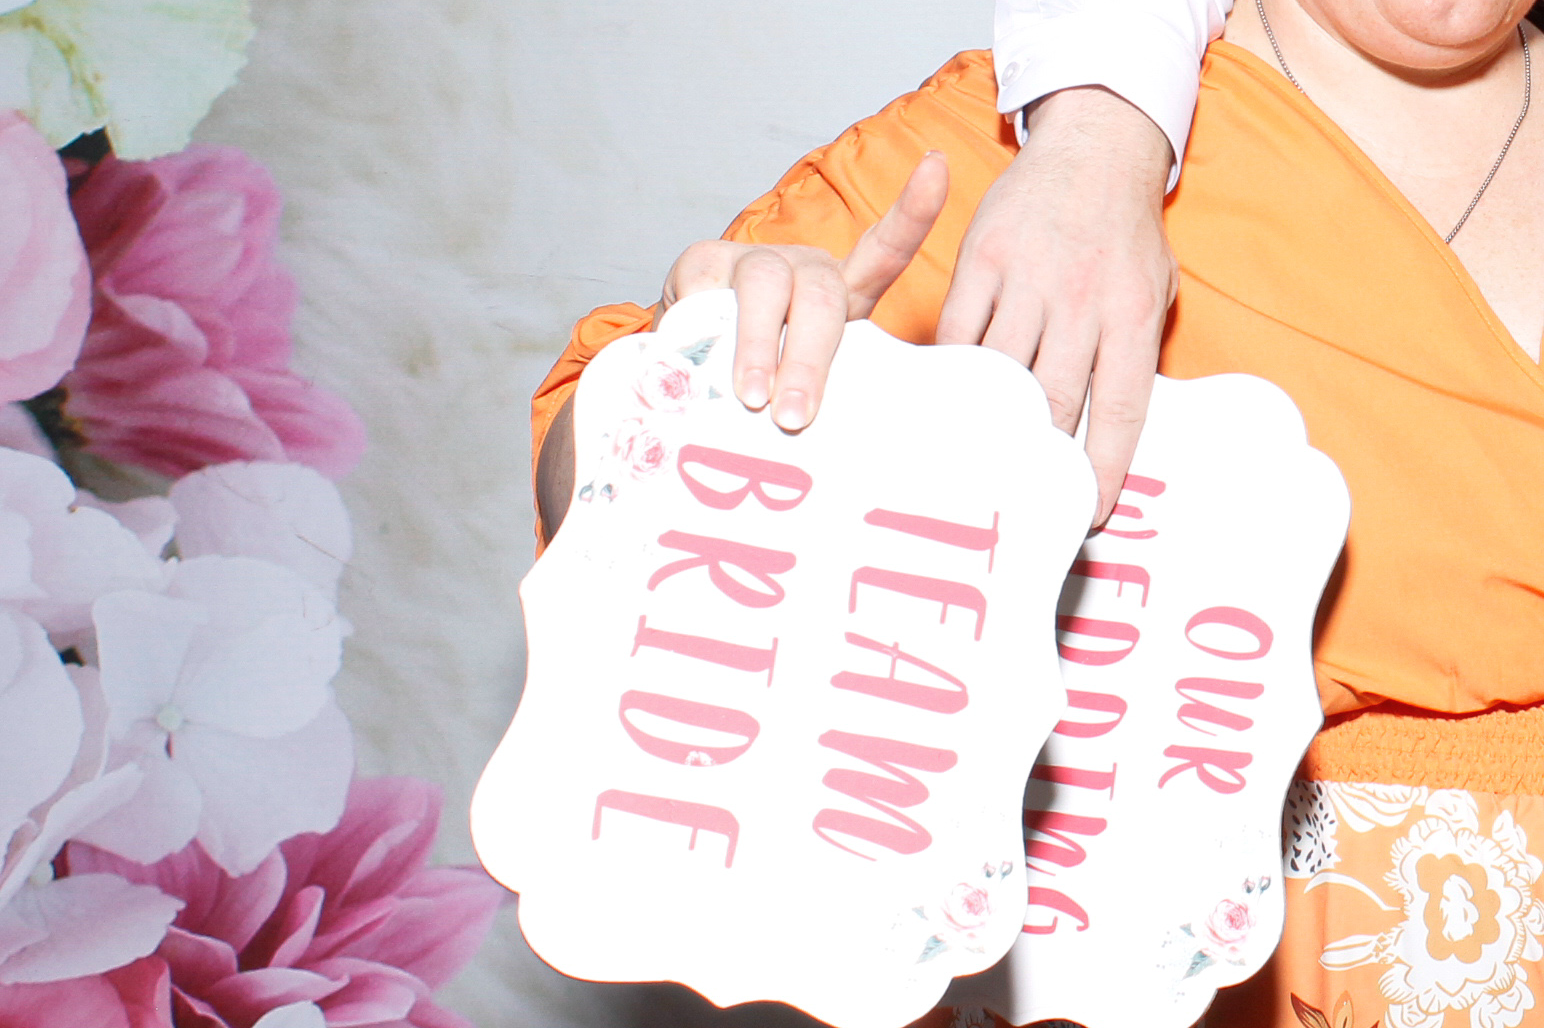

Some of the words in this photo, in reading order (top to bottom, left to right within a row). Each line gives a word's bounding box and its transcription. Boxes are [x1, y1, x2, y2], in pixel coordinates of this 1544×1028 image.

[592, 443, 813, 869] BRIDE
[813, 508, 999, 861] TEAM
[1157, 605, 1274, 795] OUR
